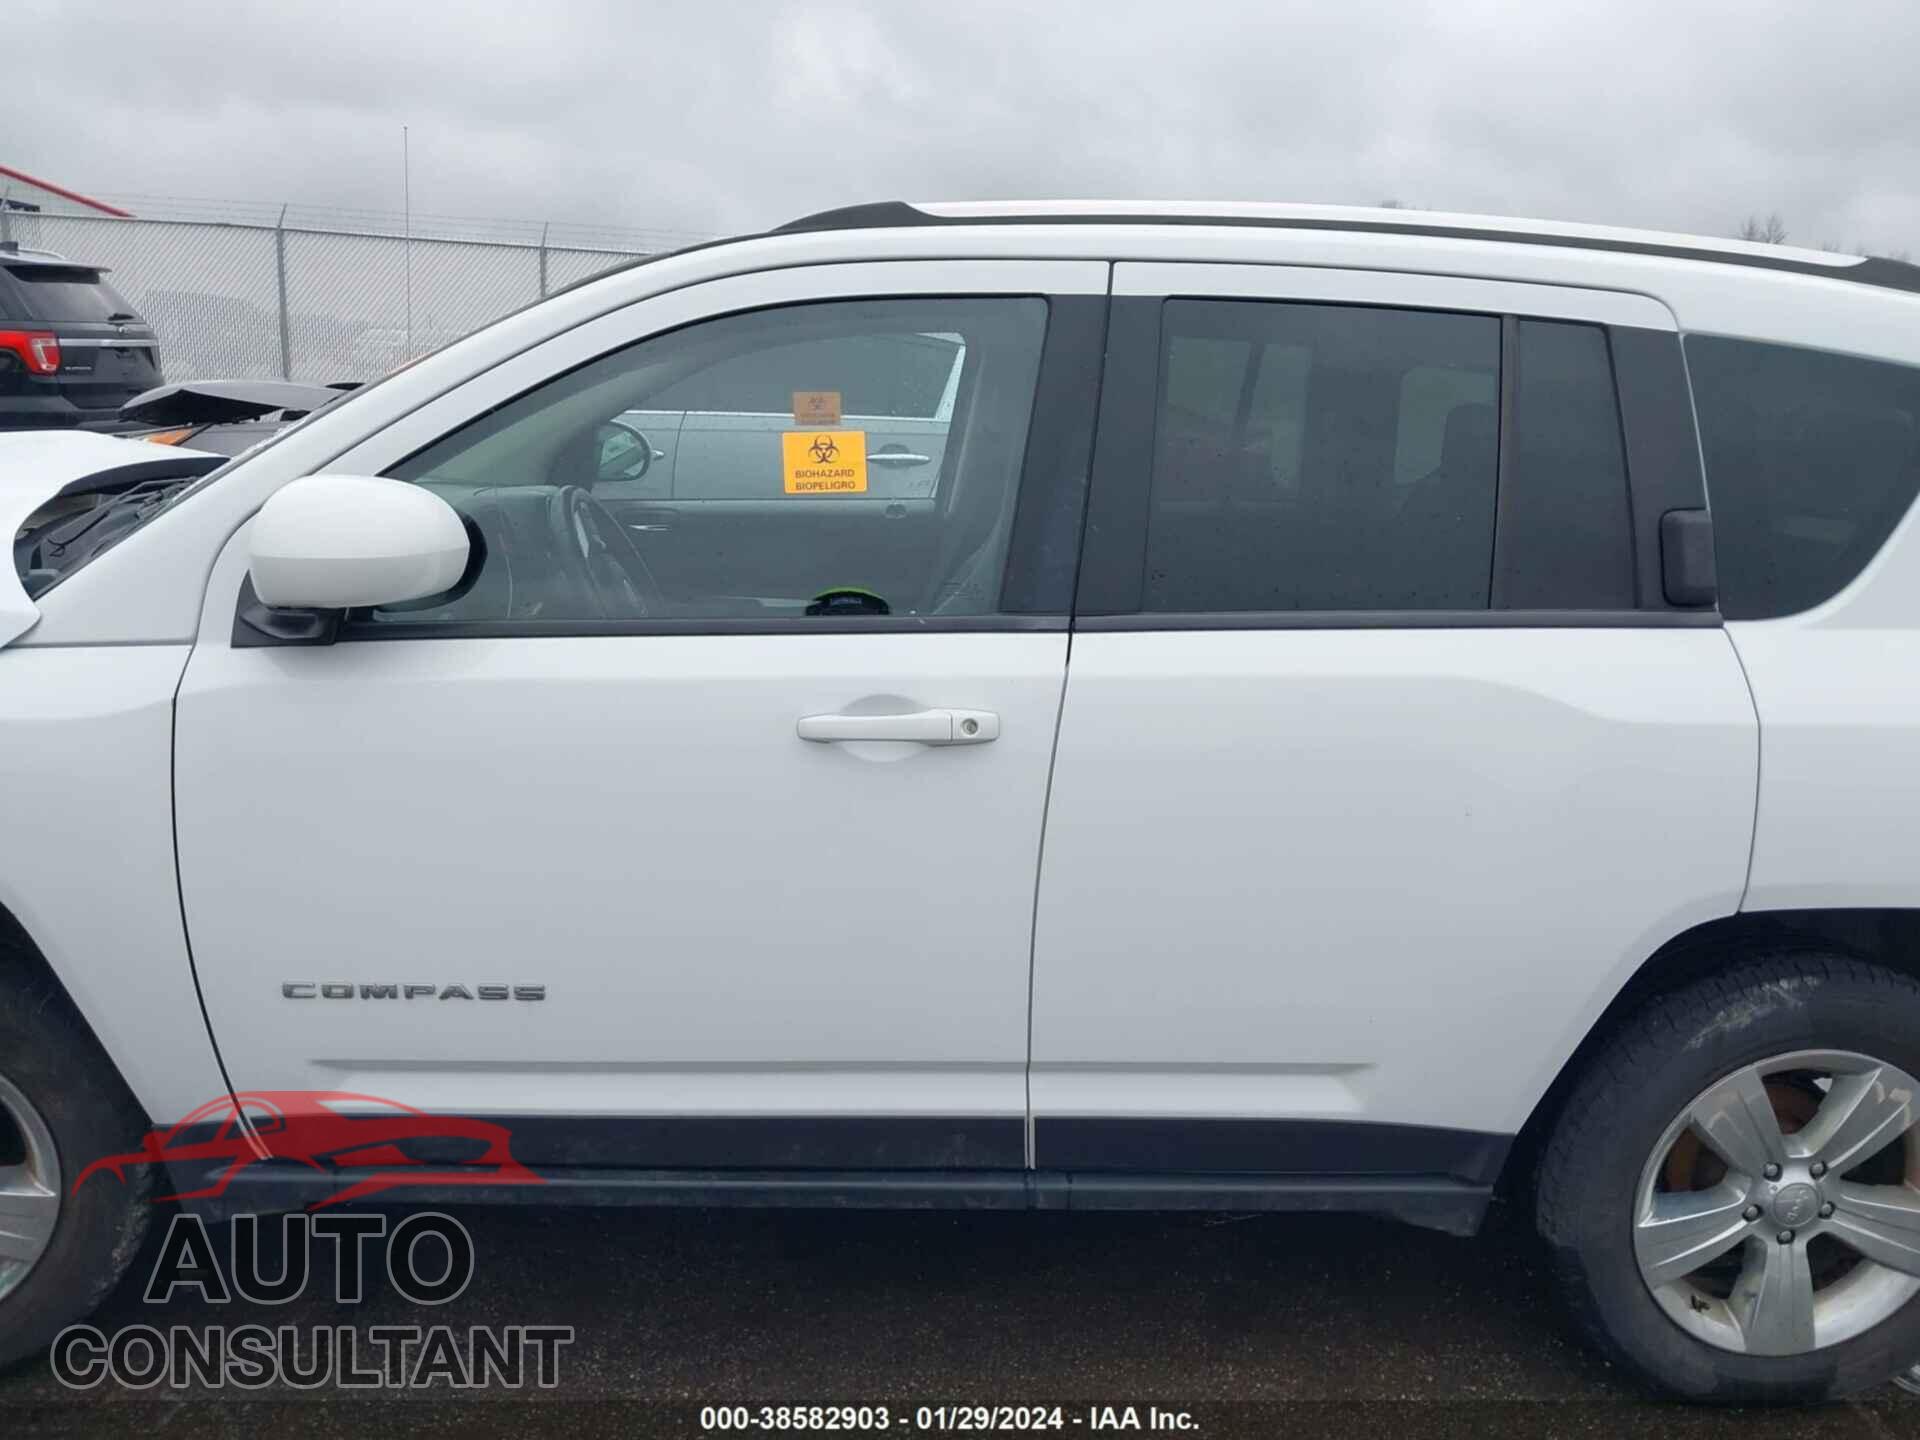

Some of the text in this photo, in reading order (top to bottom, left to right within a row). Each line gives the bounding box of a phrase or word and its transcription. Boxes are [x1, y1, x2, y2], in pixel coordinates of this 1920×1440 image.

[794, 469, 855, 479] BIOHAZARD
[795, 481, 856, 490] BIOPELIGRO
[281, 983, 546, 1001] COMPASS
